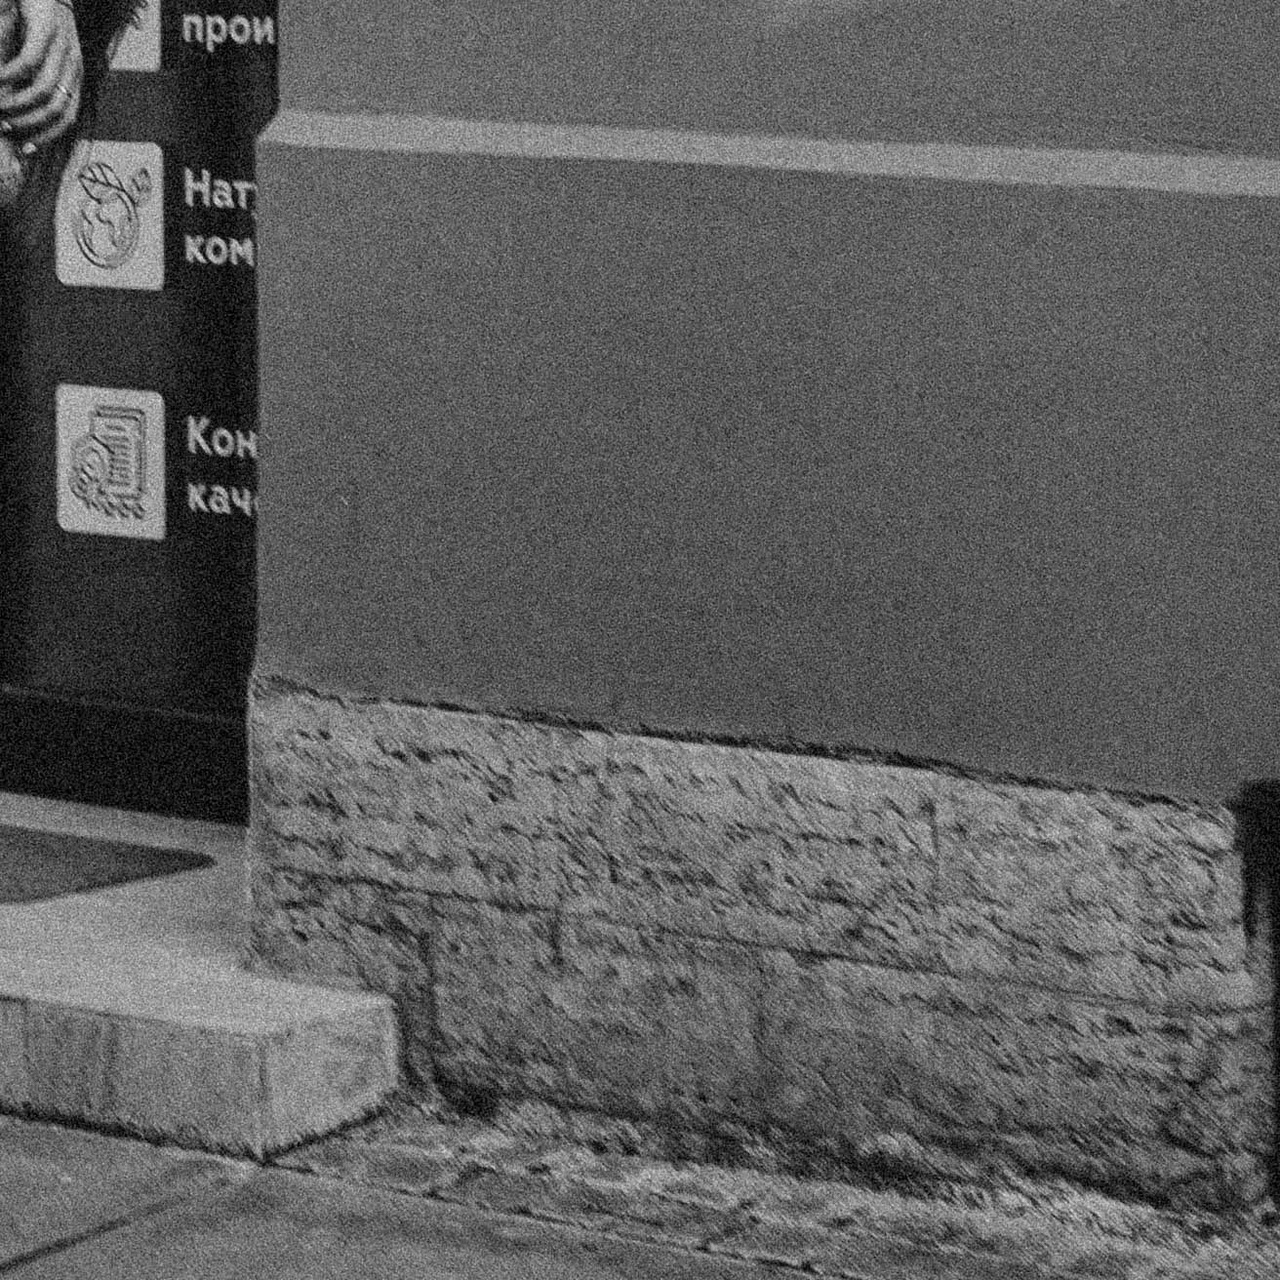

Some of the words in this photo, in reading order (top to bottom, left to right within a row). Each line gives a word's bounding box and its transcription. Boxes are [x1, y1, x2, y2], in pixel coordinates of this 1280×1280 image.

[182, 14, 276, 53] прои
[184, 234, 256, 267] ком
[187, 414, 259, 458] Кон
